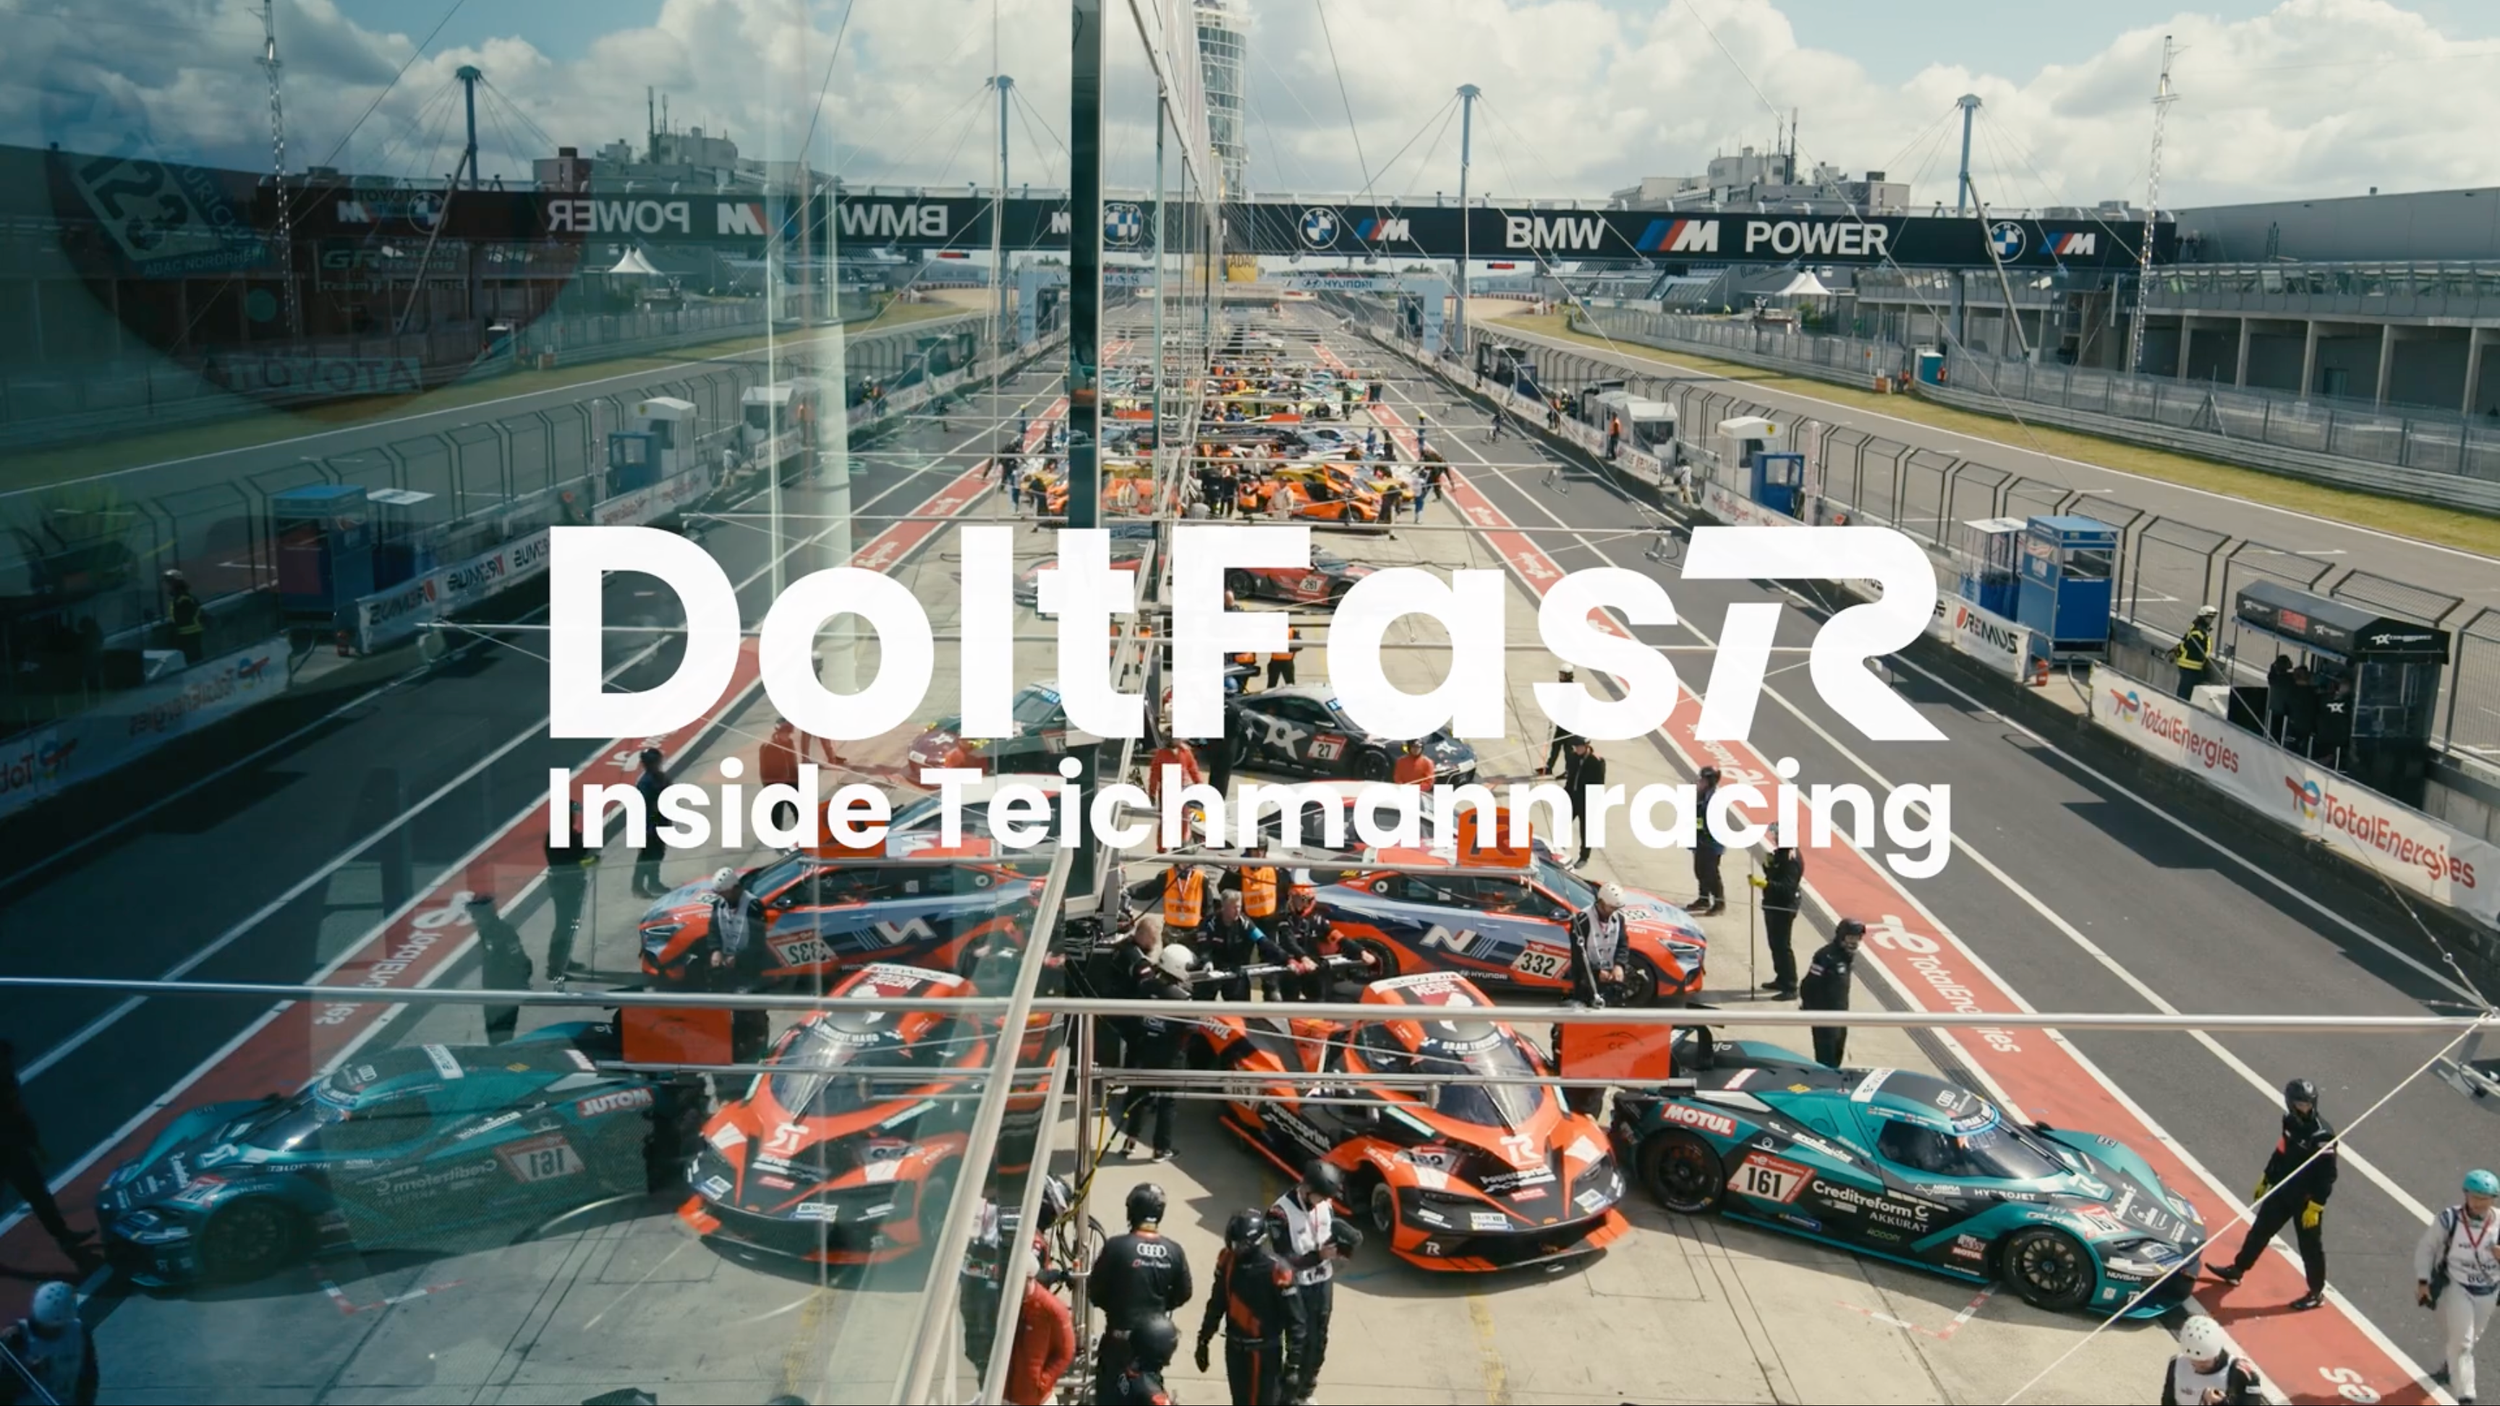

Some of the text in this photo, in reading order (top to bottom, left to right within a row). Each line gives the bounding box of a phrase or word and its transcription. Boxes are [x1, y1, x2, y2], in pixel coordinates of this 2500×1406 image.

[1505, 216, 1606, 250] BMW
[1744, 219, 1890, 256] POWER
[1323, 279, 1373, 289] HYUNDAI
[1962, 610, 2019, 654] REMUS
[1317, 743, 1332, 758] 27
[2139, 700, 2240, 774] TotalEnergies
[2323, 792, 2477, 890] TotalEnergies
[1470, 970, 1508, 980] HYUNDAI
[1520, 951, 1556, 977] 332
[1663, 1104, 1733, 1135] MOTUL
[1747, 1166, 1783, 1198] 161
[1811, 1178, 1913, 1219] Creditreform
[1869, 1211, 1930, 1233] AKKURAT
